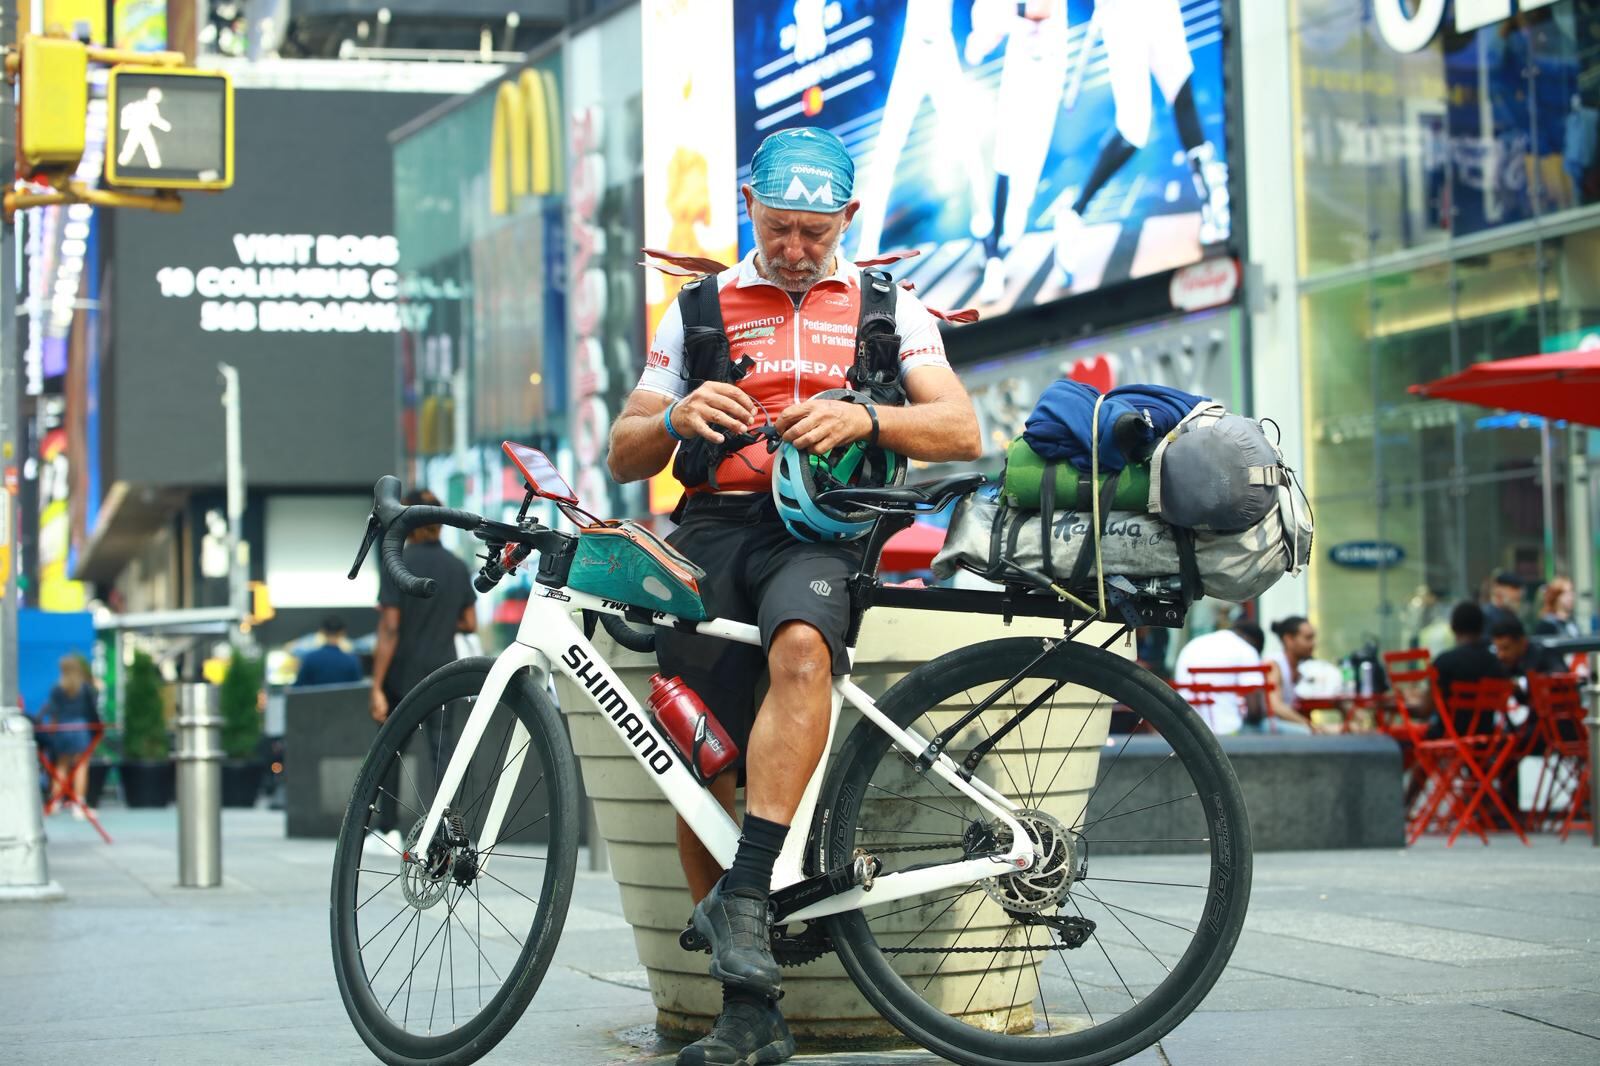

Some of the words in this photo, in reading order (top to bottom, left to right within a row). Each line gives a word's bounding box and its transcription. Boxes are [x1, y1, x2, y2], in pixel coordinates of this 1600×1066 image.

[232, 233, 315, 264] VISIT
[316, 235, 400, 266] BOSS
[196, 266, 370, 299] COLUMBUS
[727, 315, 785, 333] SHIMANO
[803, 318, 854, 333] Pedaleando
[811, 334, 821, 344] el
[560, 644, 674, 776] SHIMANO
